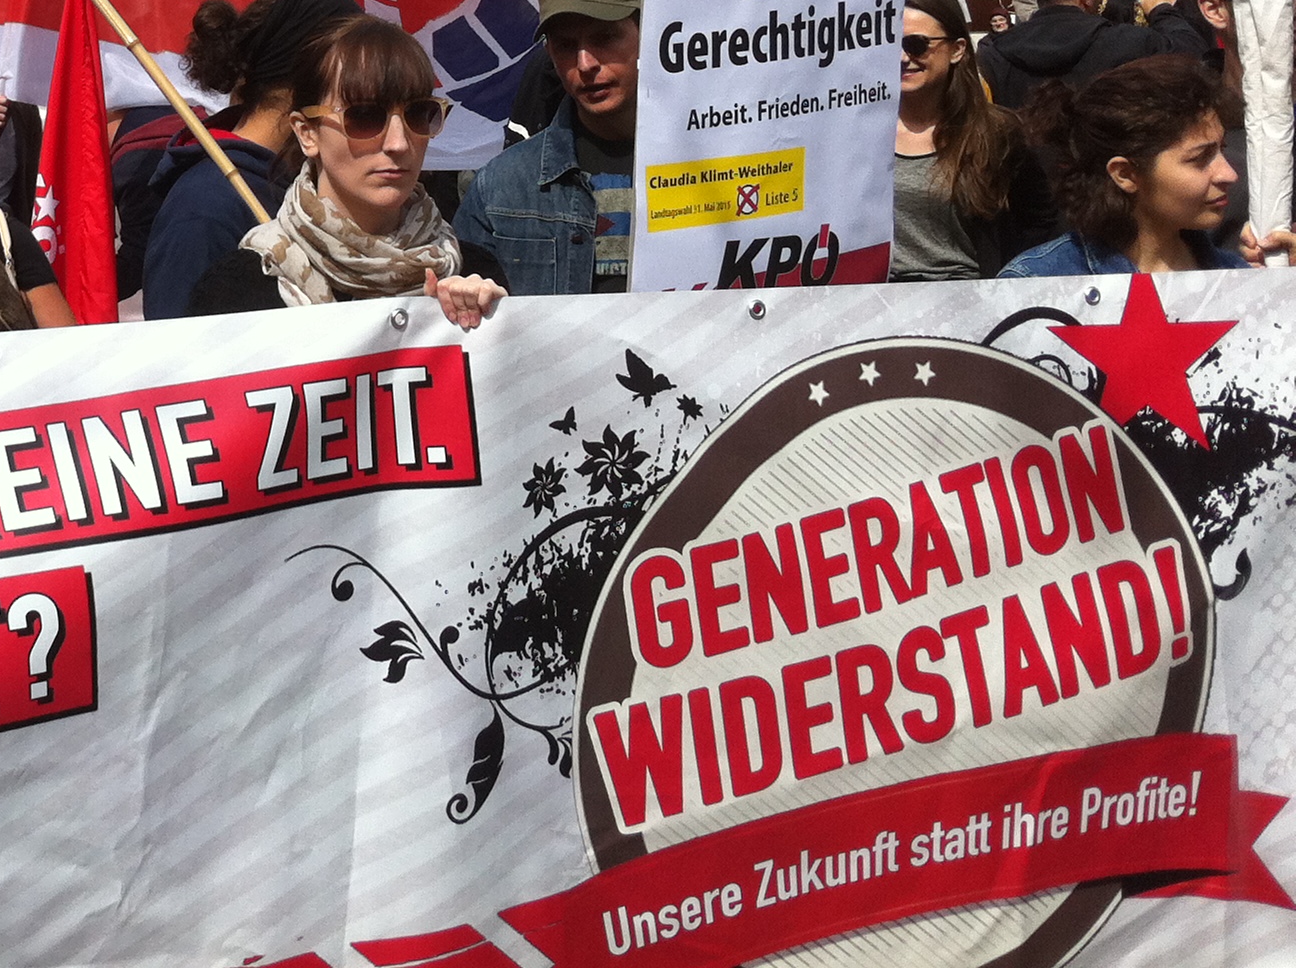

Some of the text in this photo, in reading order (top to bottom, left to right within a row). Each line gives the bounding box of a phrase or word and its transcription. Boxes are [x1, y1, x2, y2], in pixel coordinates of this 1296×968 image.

[686, 81, 892, 131] Arbeit. Frieden. Freiheit.
[649, 161, 794, 190] Claudia Klimt-Weithaler
[765, 191, 790, 207] Liste
[244, 366, 451, 492] ZEIT.
[628, 424, 1125, 669] GENERATION
[593, 545, 1190, 829] WIDERSTAND!
[603, 772, 1202, 958] Unsere Zukunft statt ihre Profite!
